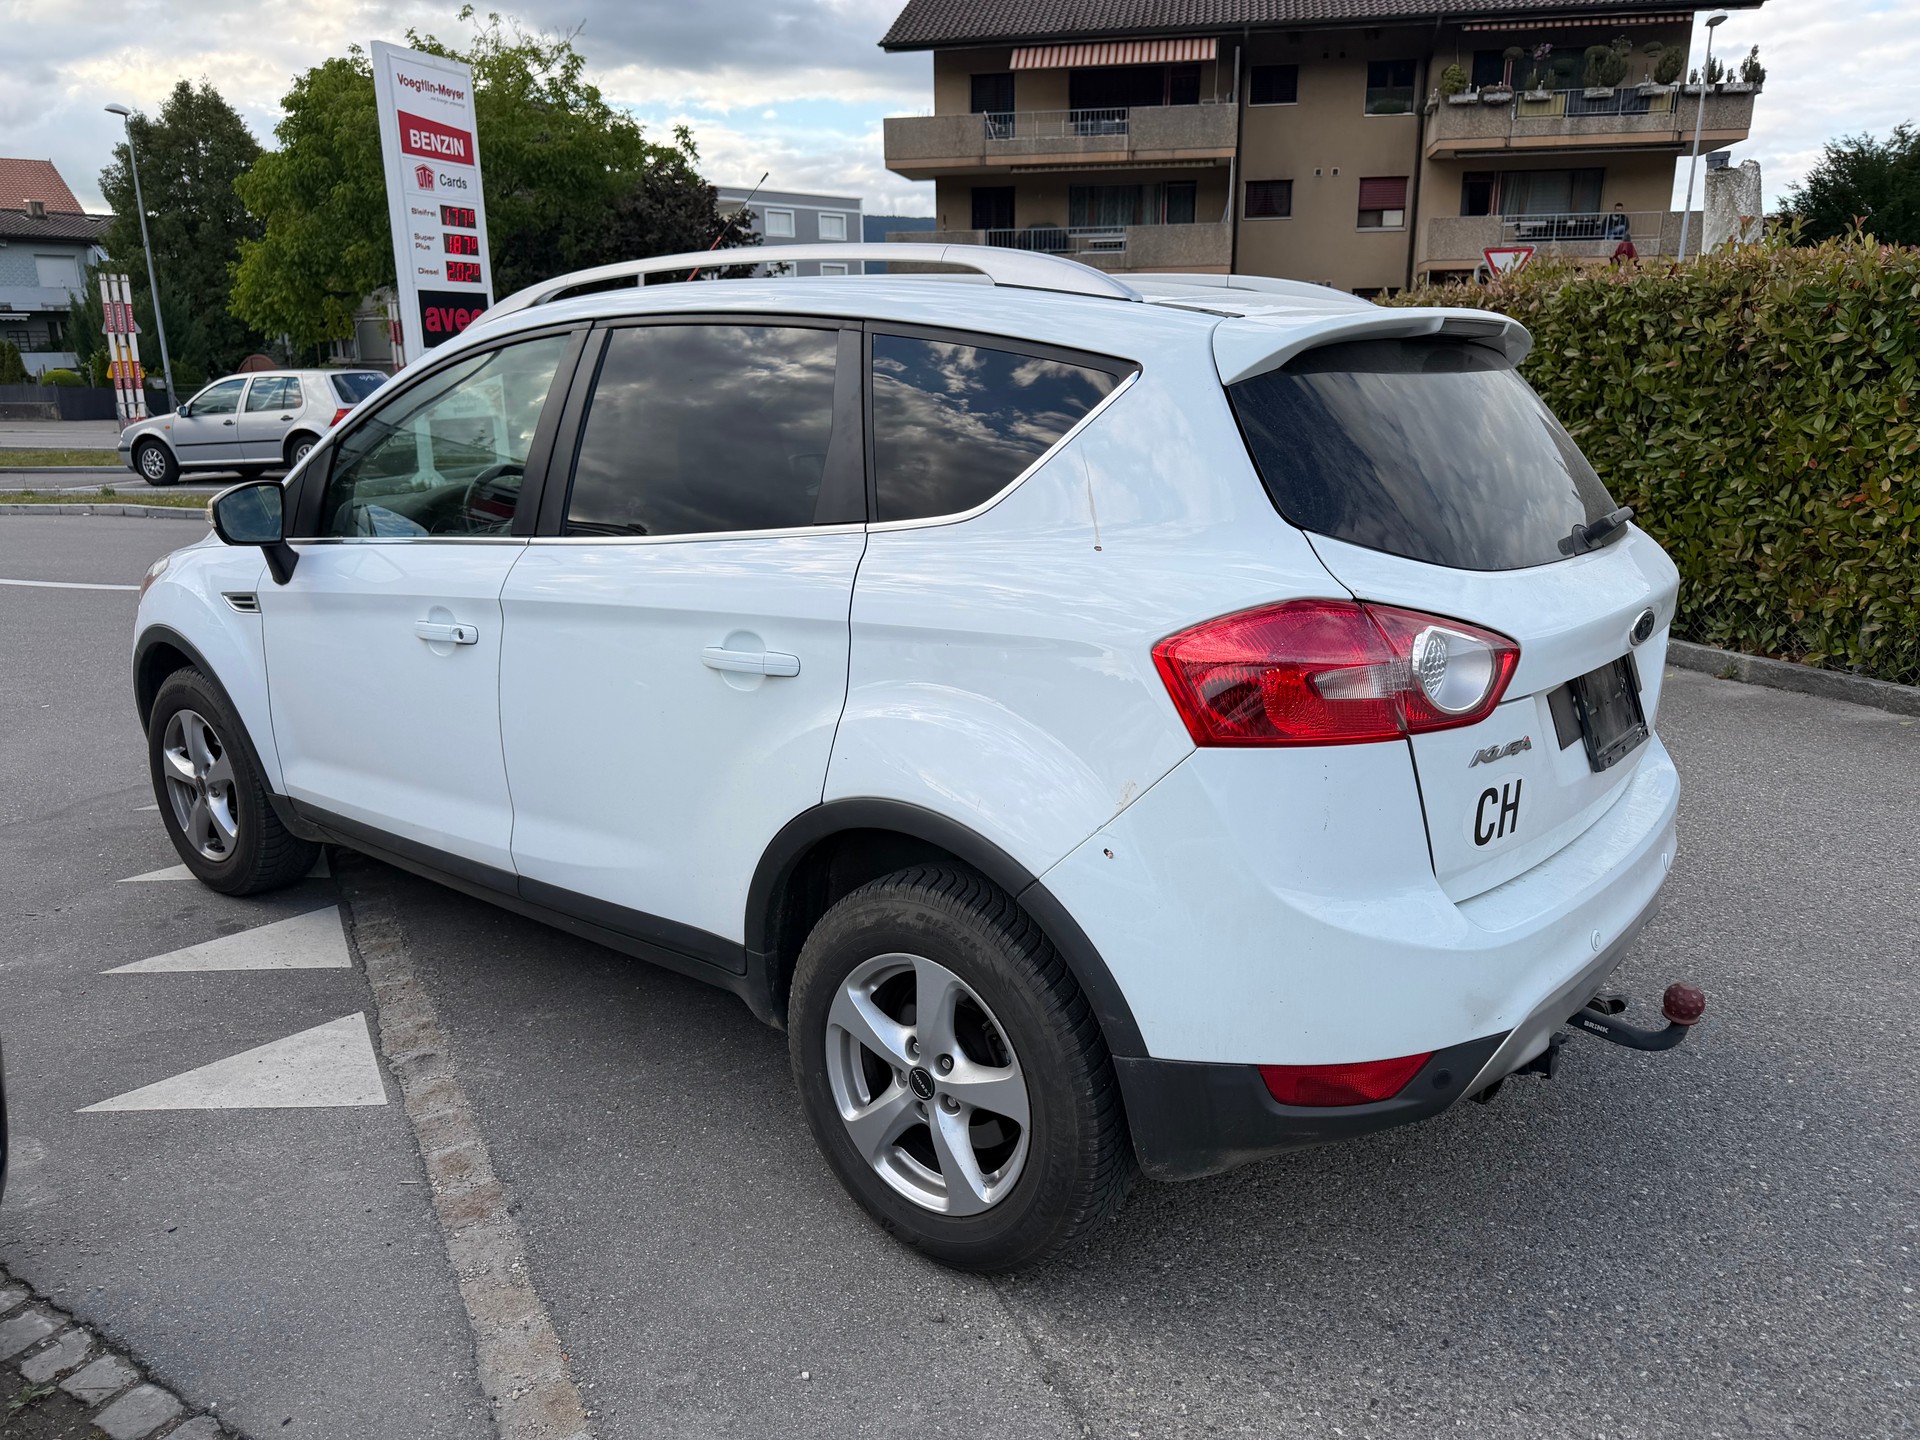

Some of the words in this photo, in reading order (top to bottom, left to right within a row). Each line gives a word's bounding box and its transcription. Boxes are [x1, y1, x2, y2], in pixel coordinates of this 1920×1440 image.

[396, 72, 465, 100] Voegtlin-Meyer
[409, 128, 465, 157] BENZIN
[439, 173, 468, 190] Cards
[414, 233, 436, 242] Super
[415, 242, 431, 251] Plus
[417, 267, 440, 276] Diesel
[1468, 735, 1533, 768] KUGA
[1474, 778, 1523, 847] CH
[1583, 1019, 1609, 1034] BRINK
